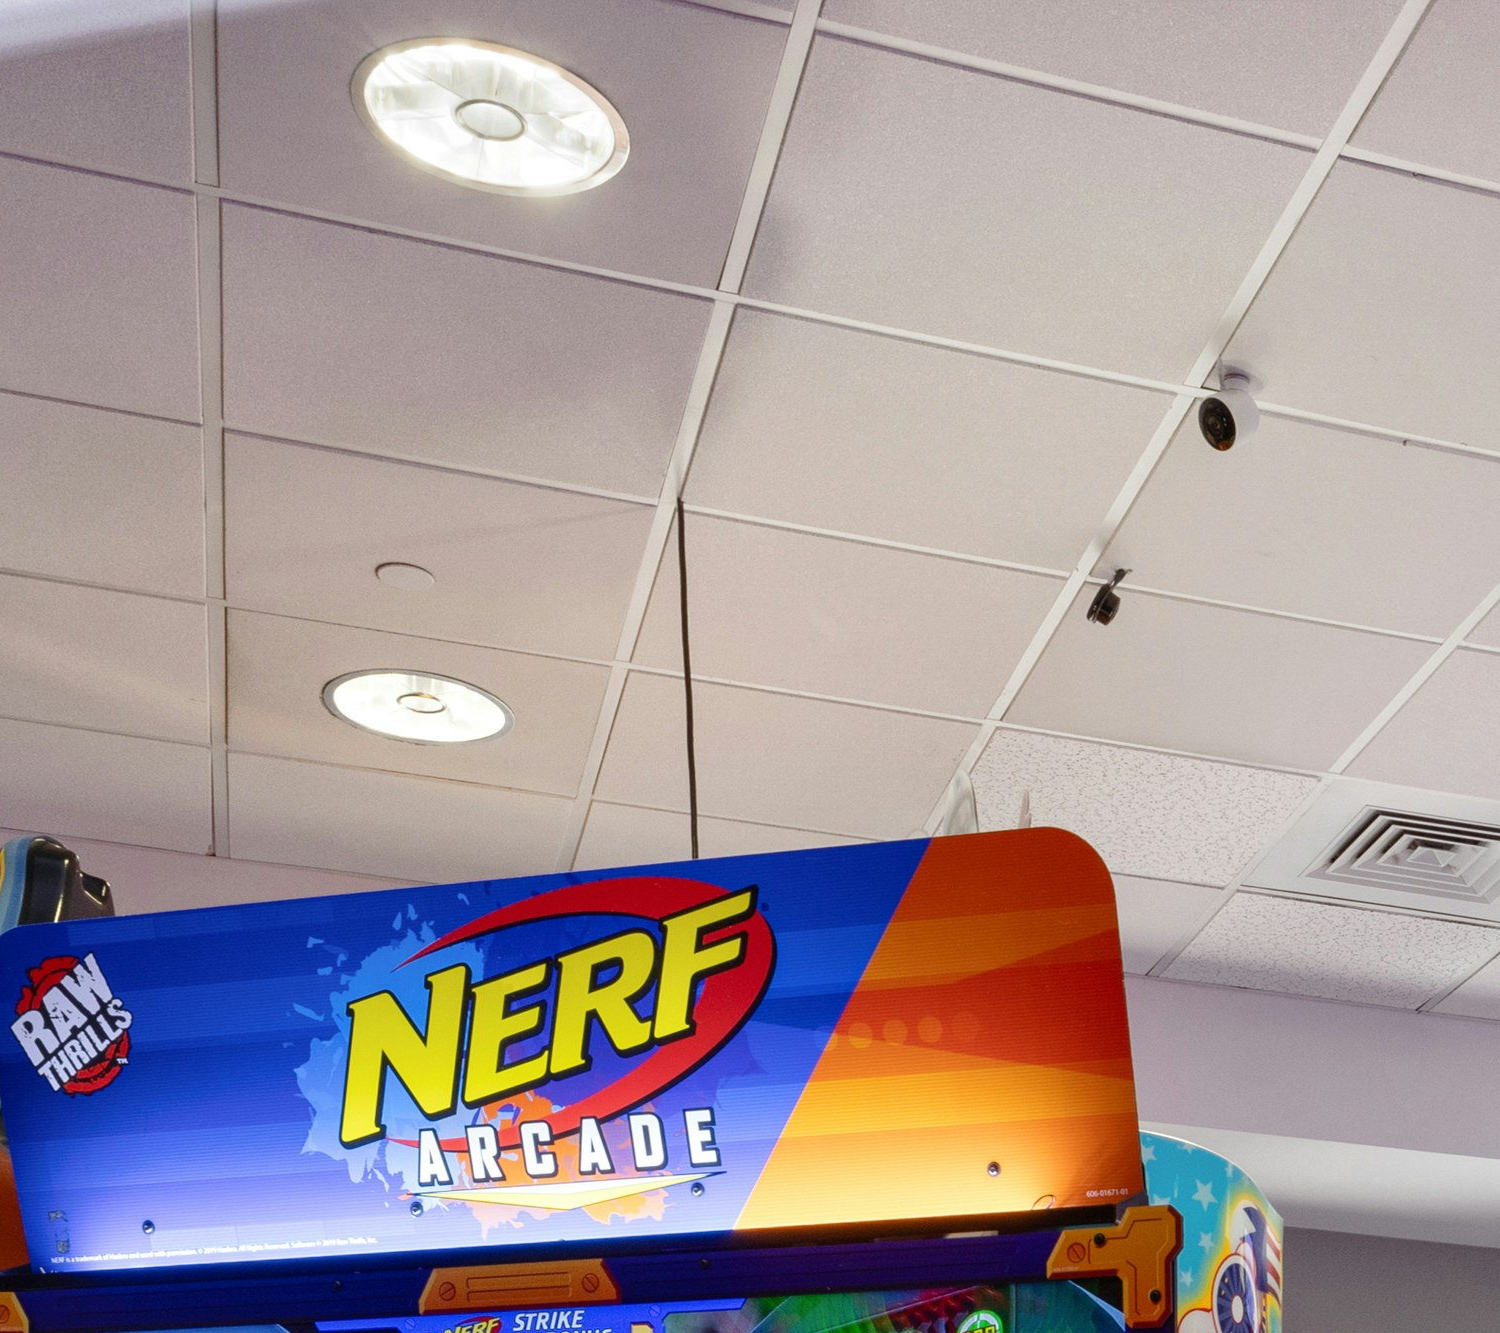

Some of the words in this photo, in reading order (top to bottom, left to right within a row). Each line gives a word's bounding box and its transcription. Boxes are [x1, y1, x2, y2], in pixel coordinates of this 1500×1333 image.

[10, 952, 114, 1067] RAW
[37, 998, 133, 1092] THRILLS
[339, 888, 761, 1148] NERF
[414, 1106, 725, 1190] ARCADE
[512, 1310, 585, 1332] STRIKE
